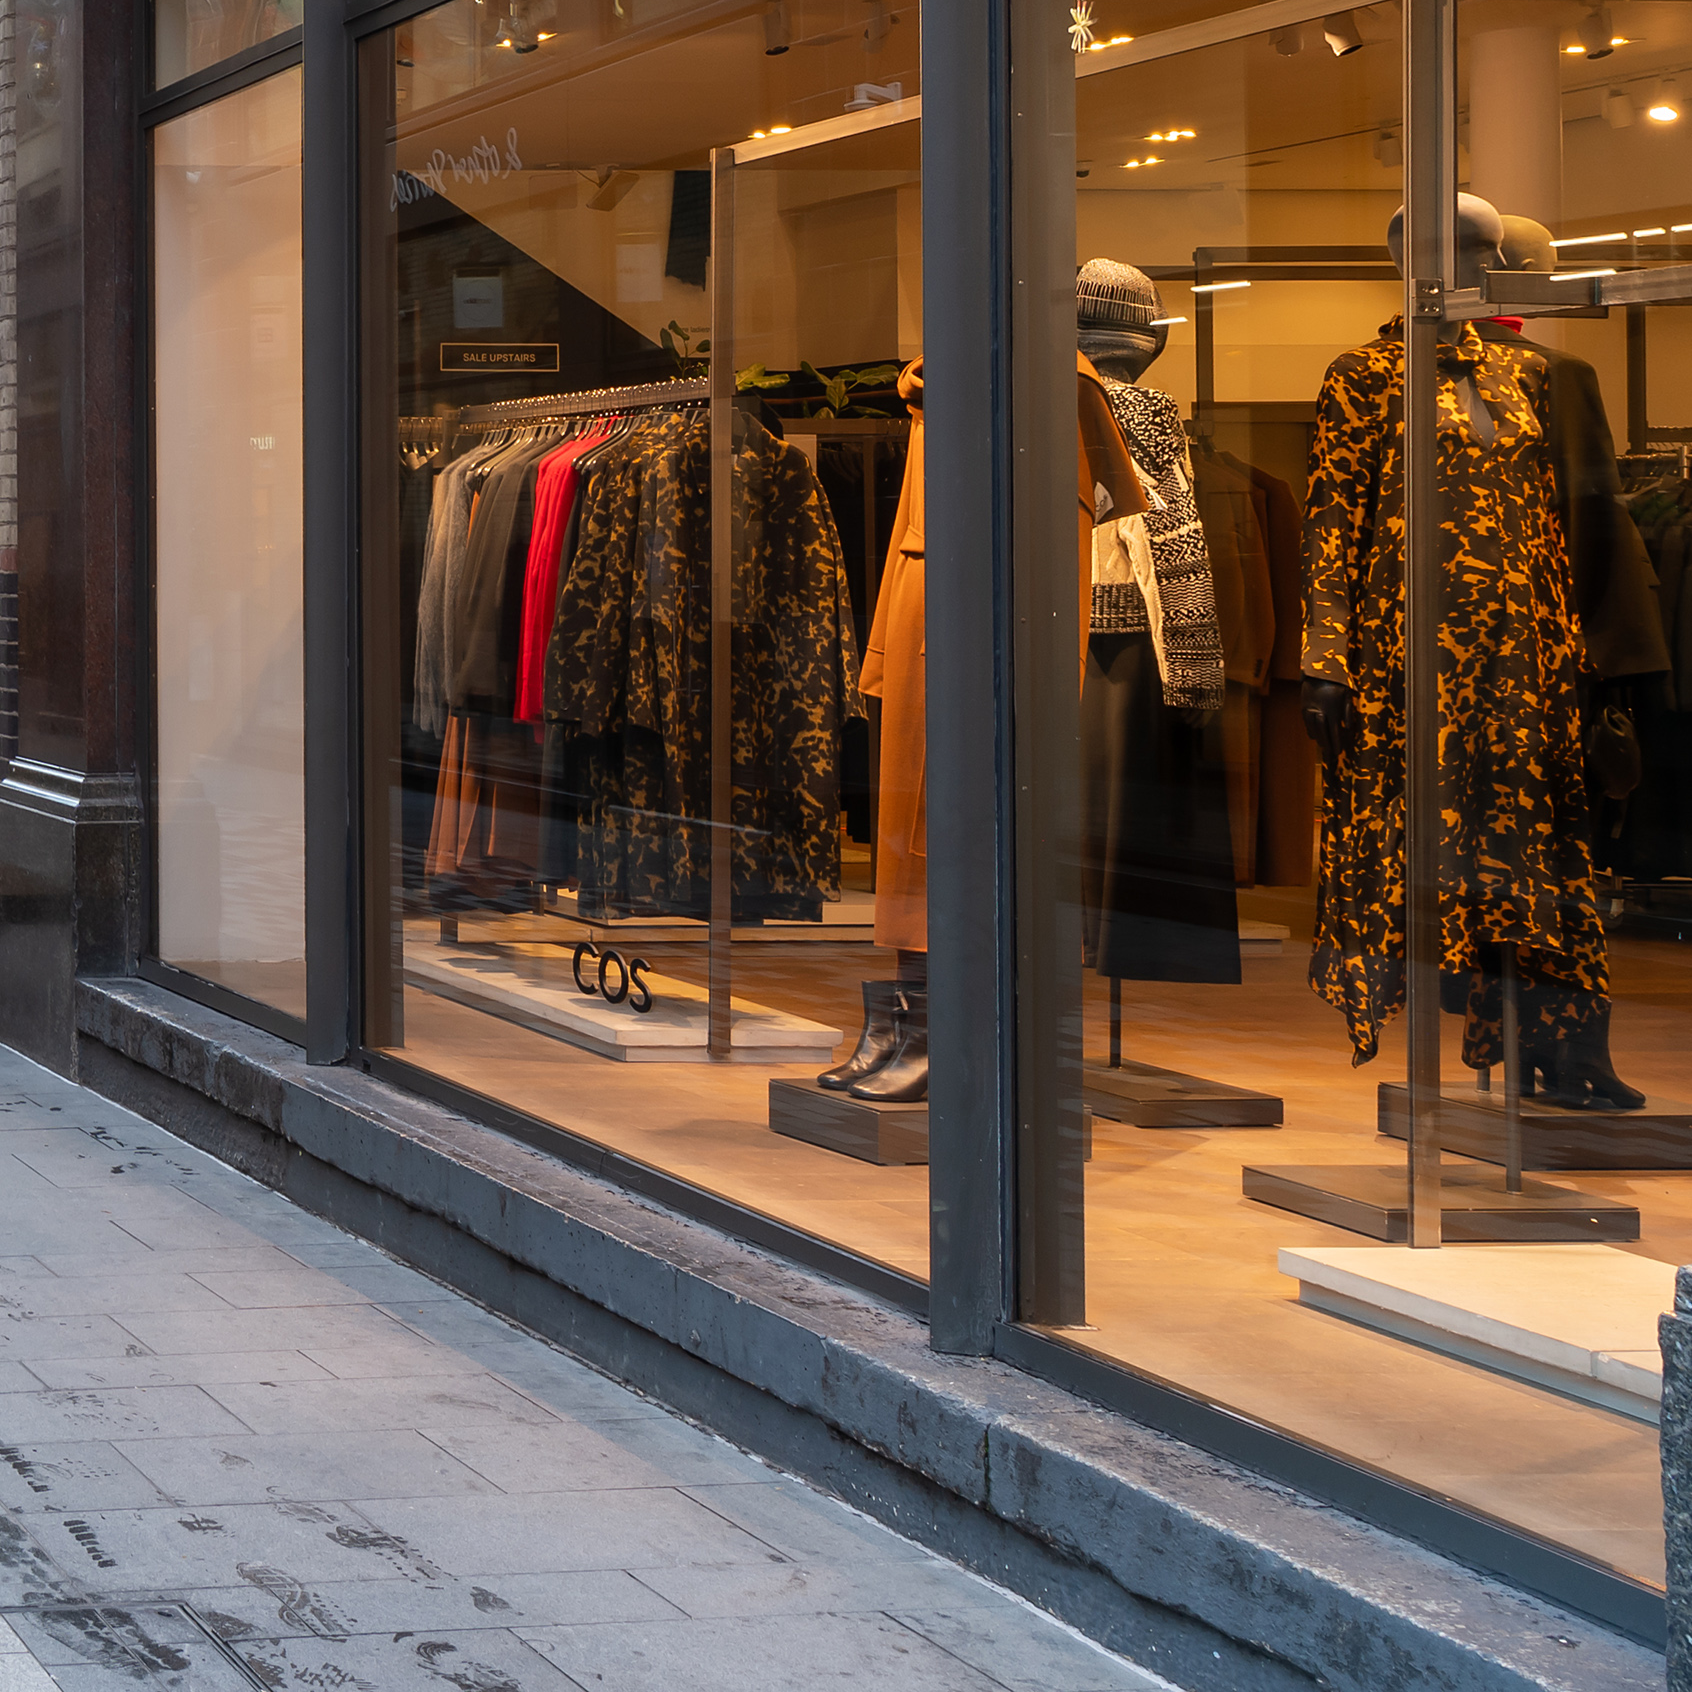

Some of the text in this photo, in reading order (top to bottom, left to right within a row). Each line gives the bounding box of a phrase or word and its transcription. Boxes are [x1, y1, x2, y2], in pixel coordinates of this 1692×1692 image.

[463, 353, 536, 362] SALE UPSTAIRS
[573, 942, 653, 1014] COS
